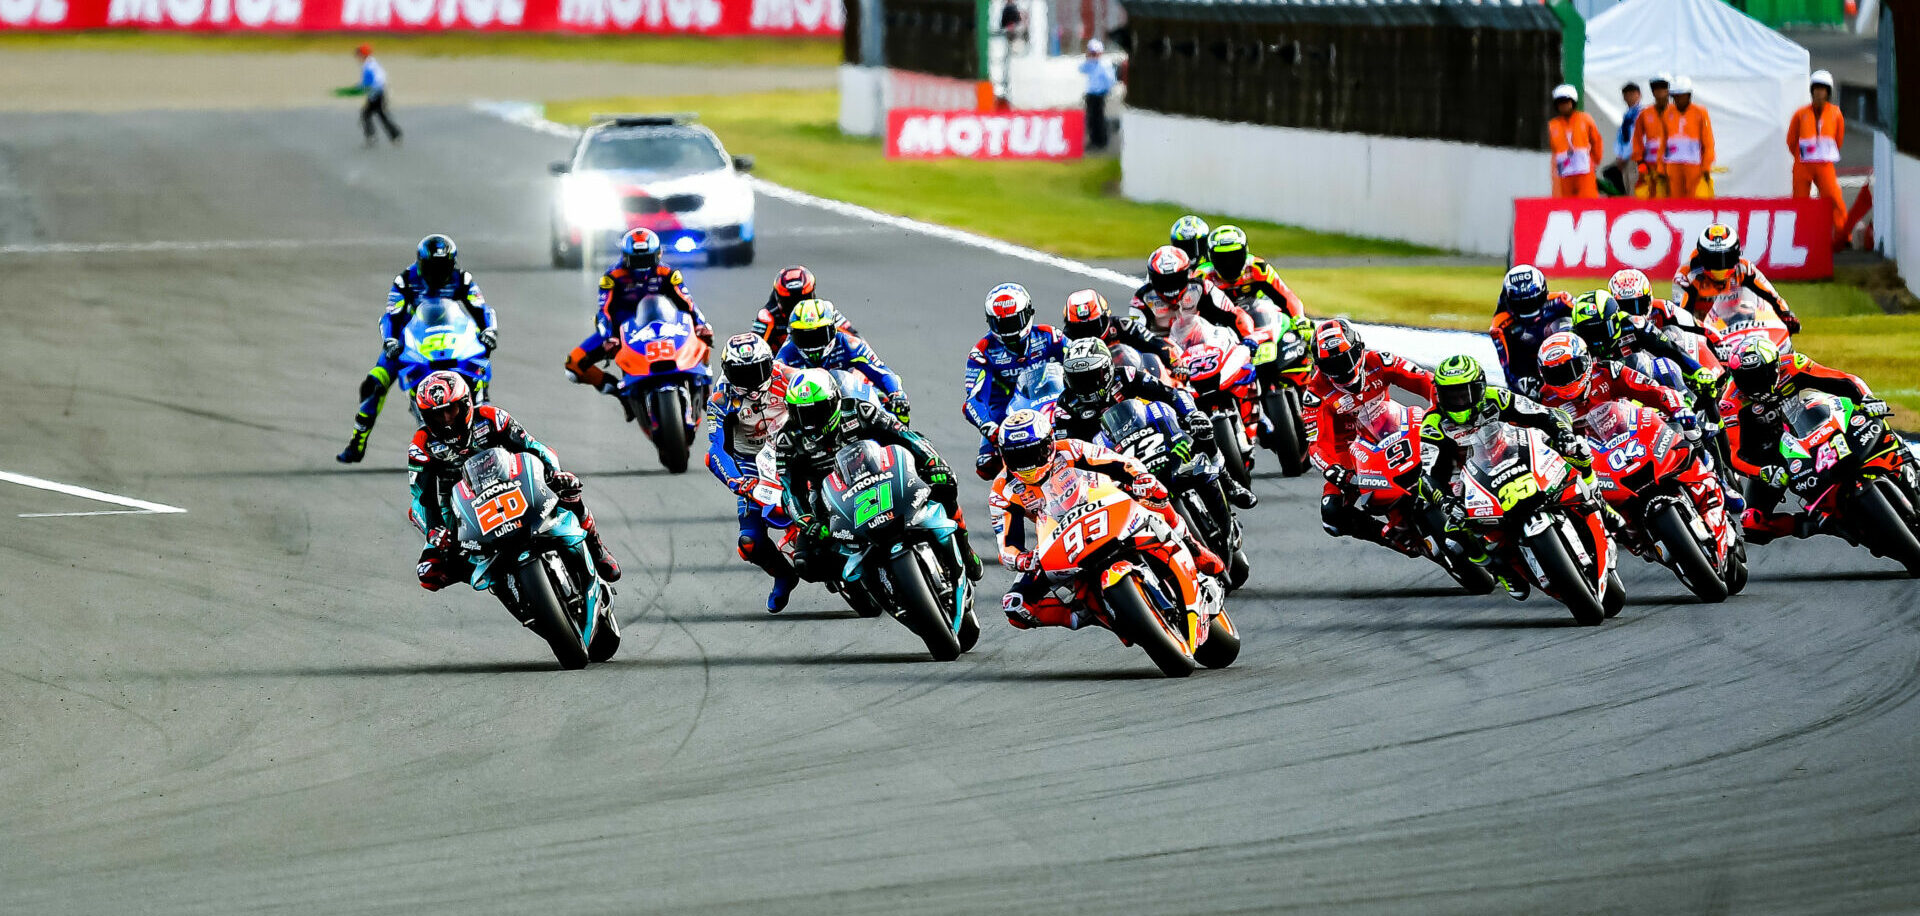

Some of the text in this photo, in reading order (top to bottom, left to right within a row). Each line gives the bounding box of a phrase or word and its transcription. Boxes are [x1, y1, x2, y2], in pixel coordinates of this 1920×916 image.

[108, 0, 302, 26] MOTUL
[341, 0, 526, 27] MOTUL
[558, 0, 722, 30] MOTUL
[750, 0, 844, 30] MOT
[897, 115, 1070, 156] MOTUL
[1534, 209, 1809, 270] MOTUL
[646, 340, 675, 361] 55
[966, 402, 984, 427] SUZUK
[1030, 393, 1060, 408] SUZUK
[1120, 427, 1155, 448] ENEOS
[1654, 429, 1674, 459] Lenovo
[1385, 438, 1413, 470] 9
[1608, 438, 1647, 471] 04
[1815, 432, 1853, 474] 41
[842, 471, 894, 502] PETRONAS
[1358, 477, 1389, 487] Lenovo
[1490, 464, 1528, 488] CUSTOM
[1597, 481, 1615, 489] ovo
[470, 480, 522, 508] PETRONAS
[853, 480, 894, 530] 21
[1498, 472, 1537, 512] 35
[474, 486, 529, 537] 20
[1052, 500, 1107, 541] REPSOL
[1062, 508, 1110, 565] 93
